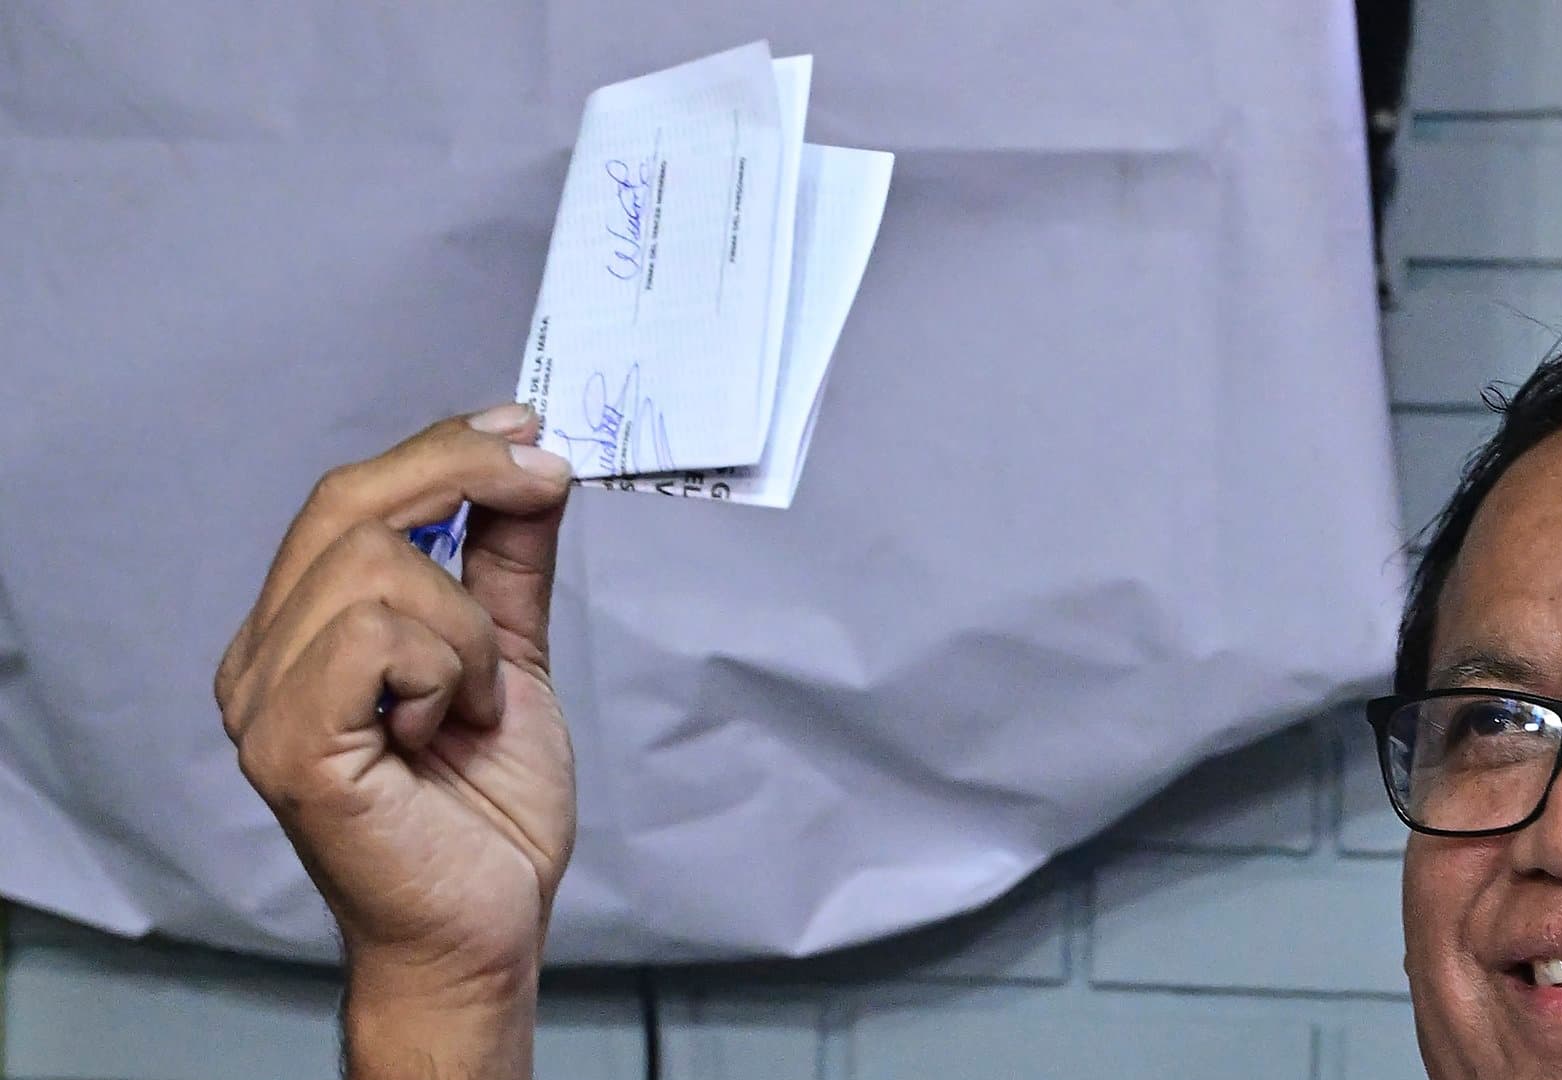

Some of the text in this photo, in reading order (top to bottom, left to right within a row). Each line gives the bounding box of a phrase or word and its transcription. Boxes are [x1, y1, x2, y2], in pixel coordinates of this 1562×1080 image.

[537, 314, 549, 352] MESA
[533, 355, 543, 373] LA
[530, 377, 540, 394] DE
